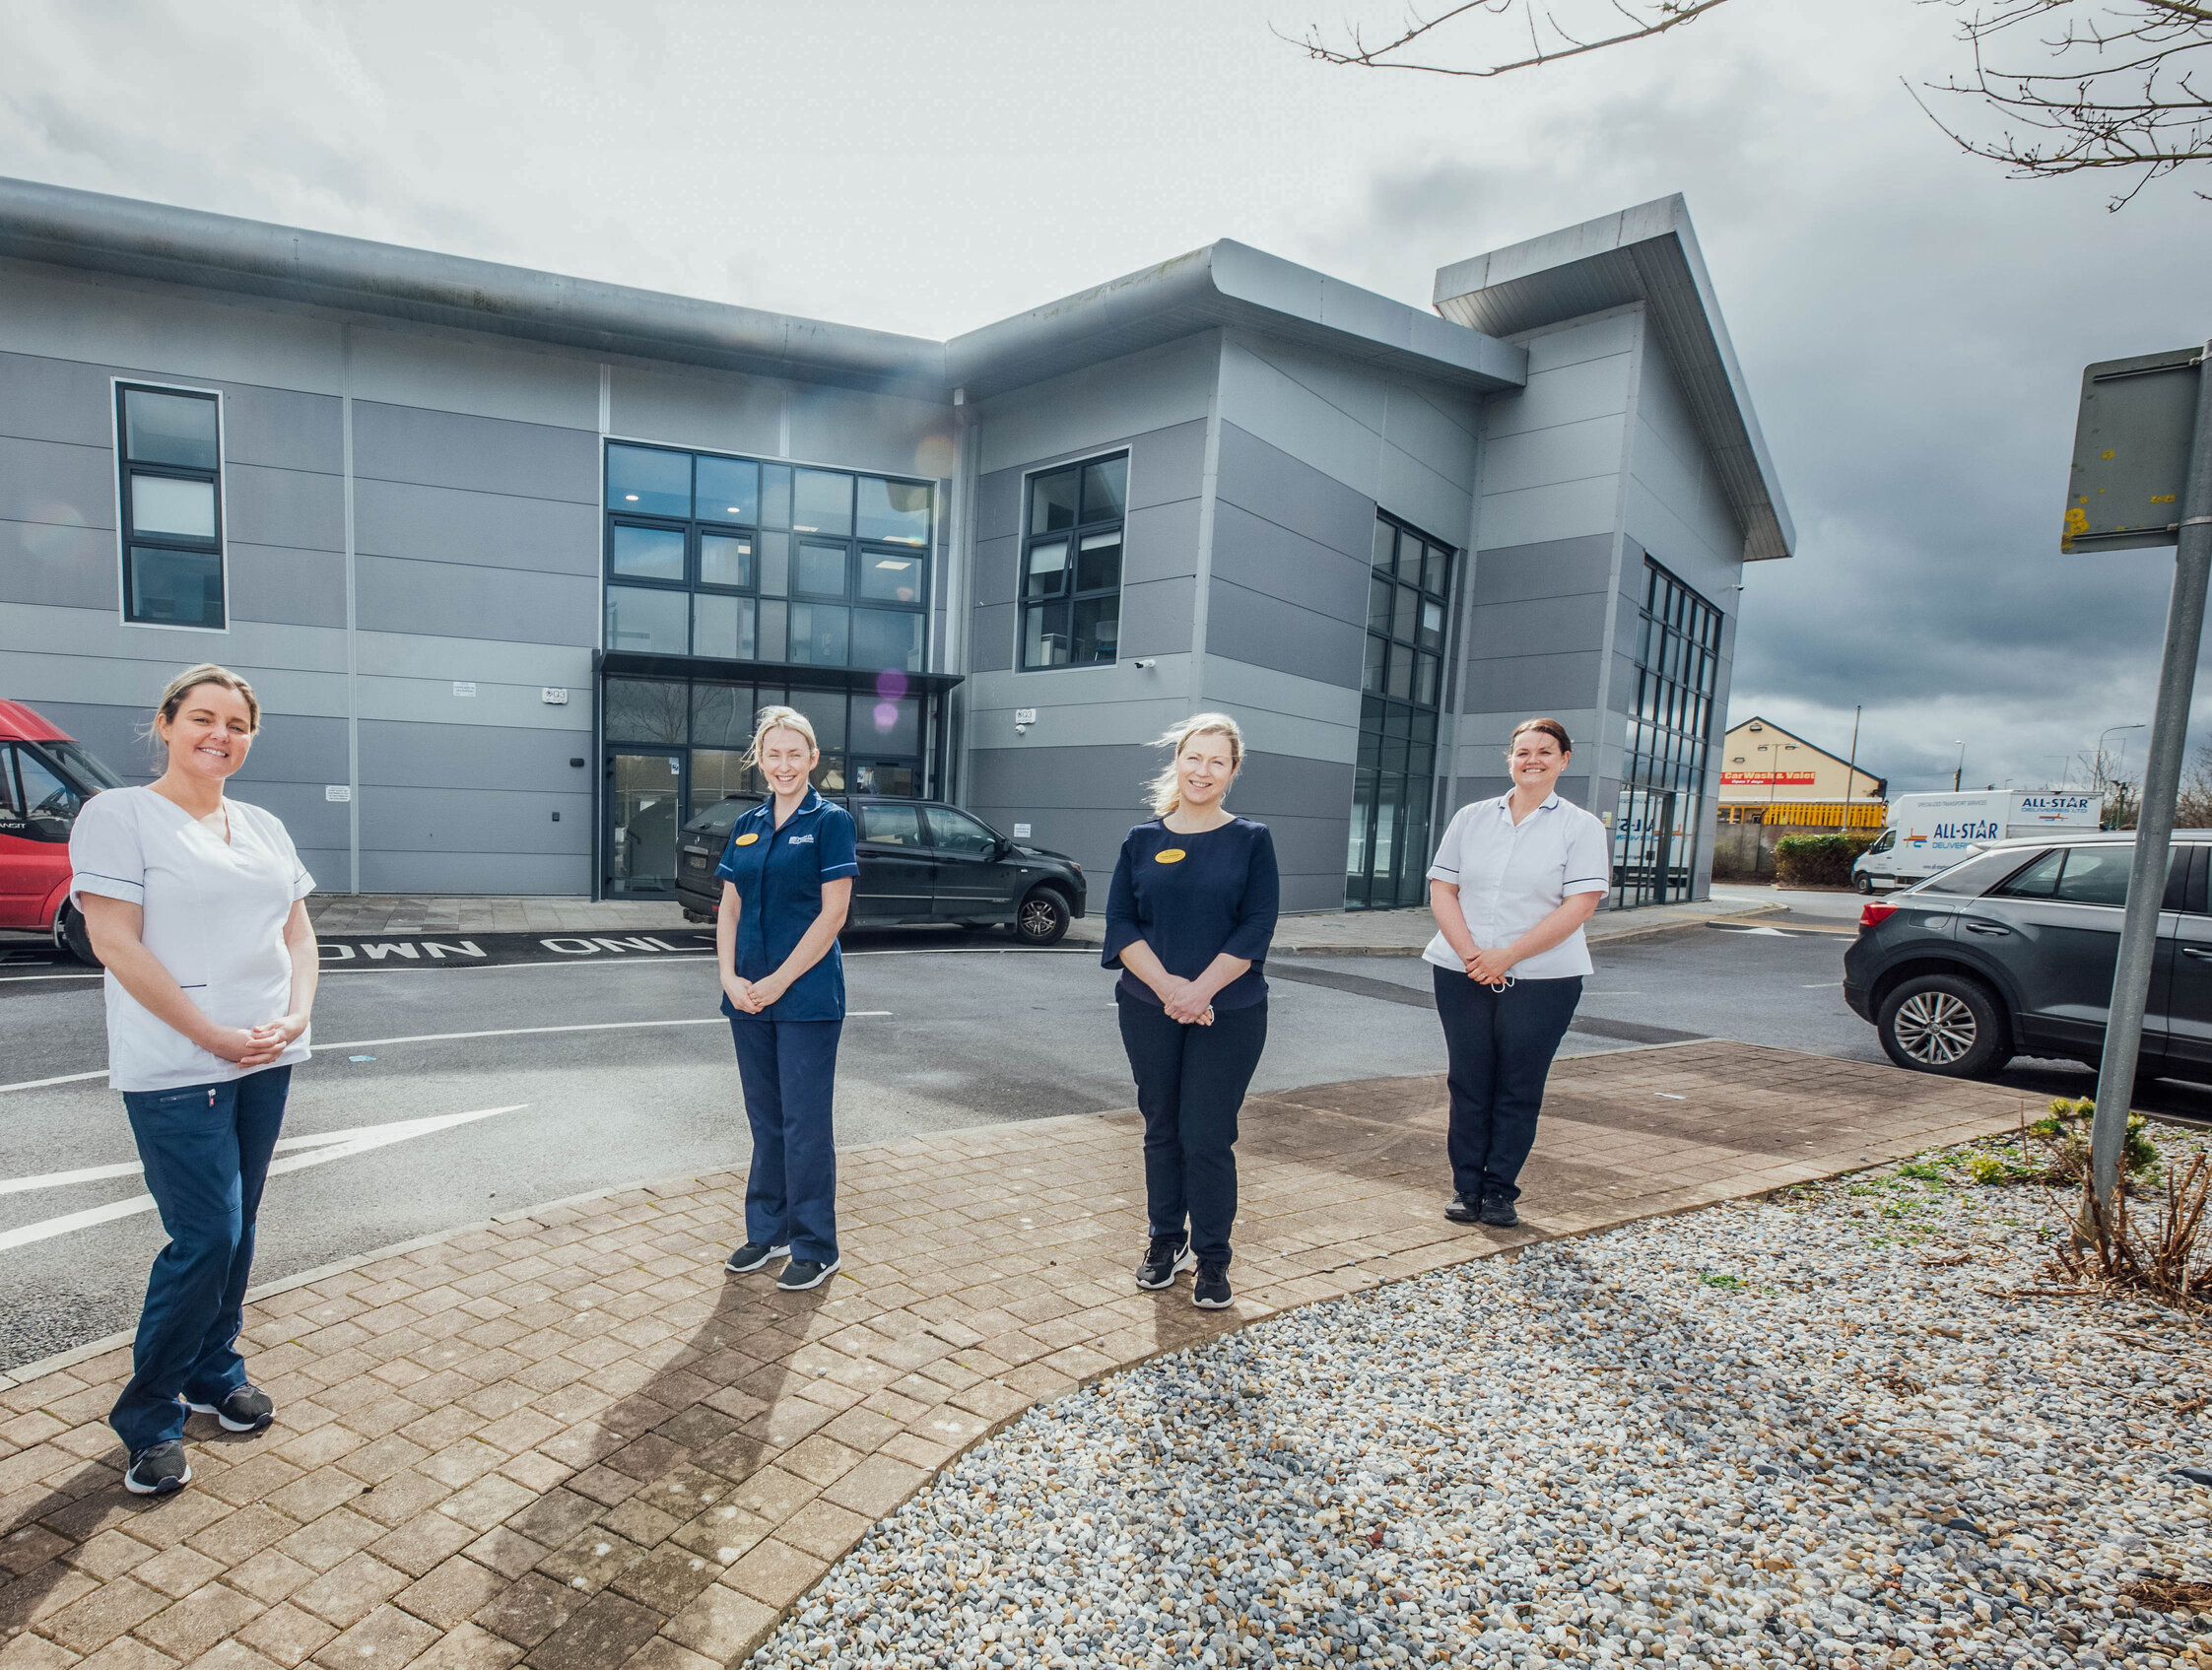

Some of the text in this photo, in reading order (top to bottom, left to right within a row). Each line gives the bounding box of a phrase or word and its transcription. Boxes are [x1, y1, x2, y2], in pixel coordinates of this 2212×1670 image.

[2022, 797, 2088, 808] ALL-STAR
[1933, 820, 1998, 838] ALL-STAR
[318, 940, 488, 961] OWN
